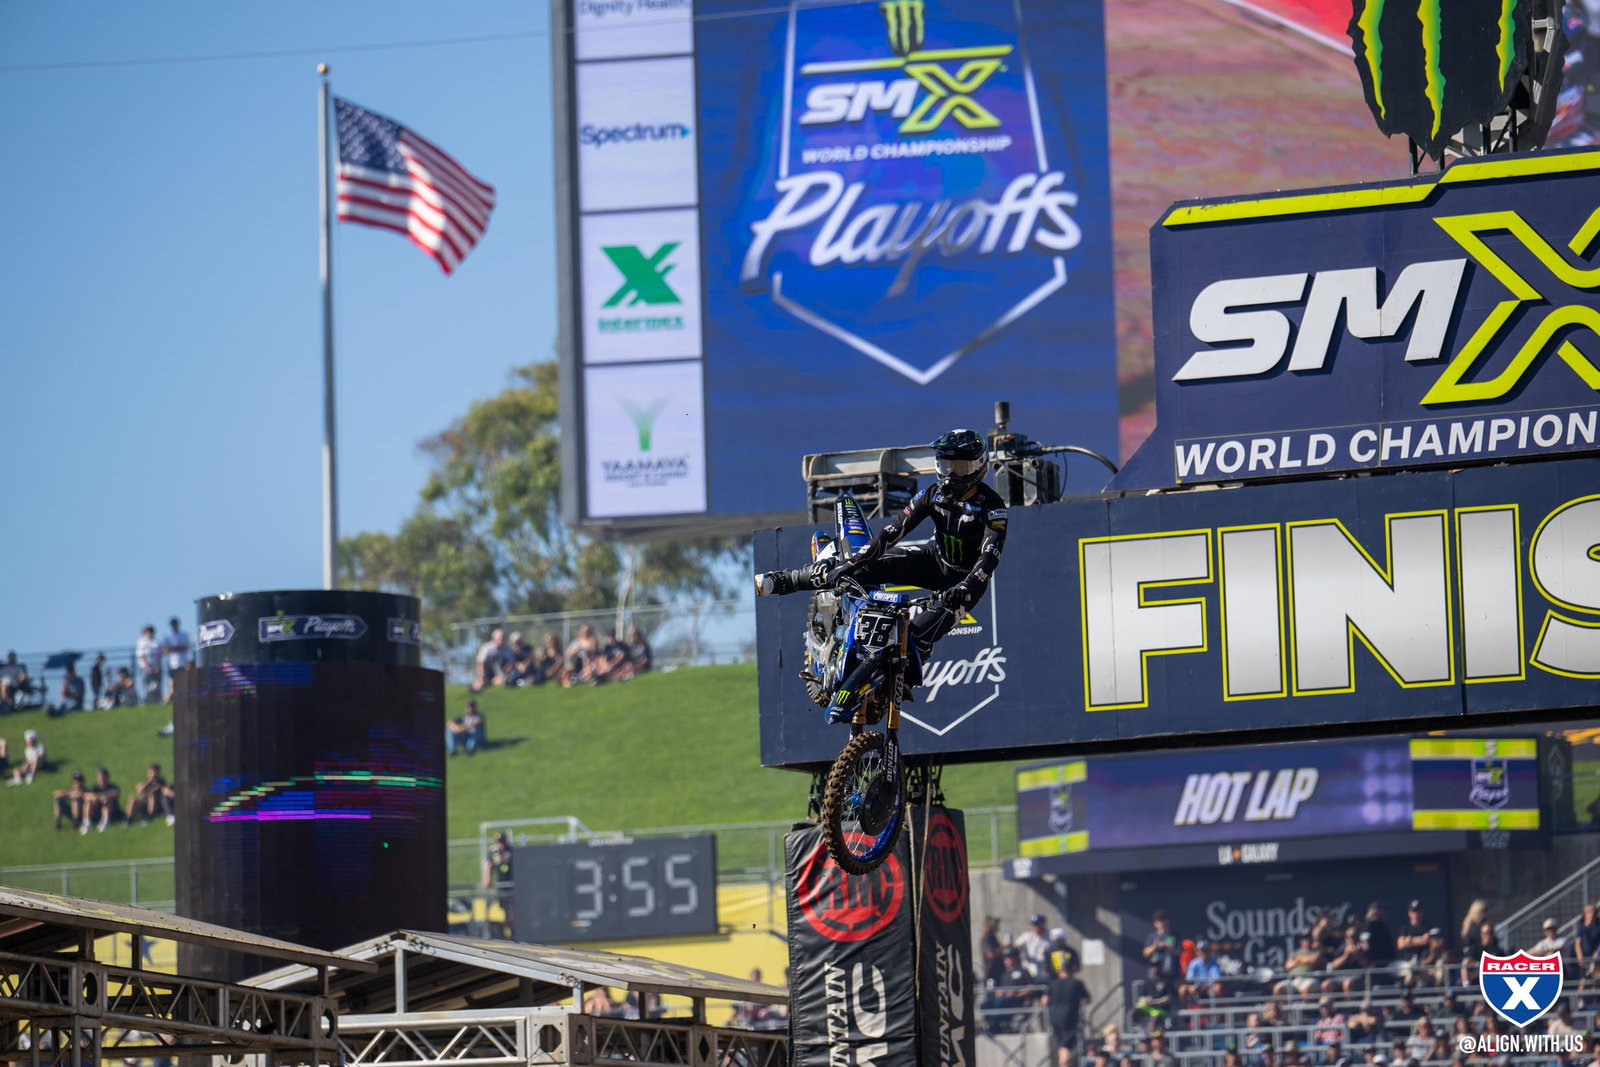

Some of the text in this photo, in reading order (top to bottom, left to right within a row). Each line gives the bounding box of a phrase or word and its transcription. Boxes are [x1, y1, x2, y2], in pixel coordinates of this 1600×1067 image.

[800, 60, 1002, 133] SMX
[580, 121, 685, 149] Spectrum
[803, 135, 1012, 164] WORLD CHAMPIONSHIP
[741, 171, 1082, 298] Playoffs
[1176, 434, 1336, 477] WORLD
[1173, 767, 1319, 826] HOT LAP
